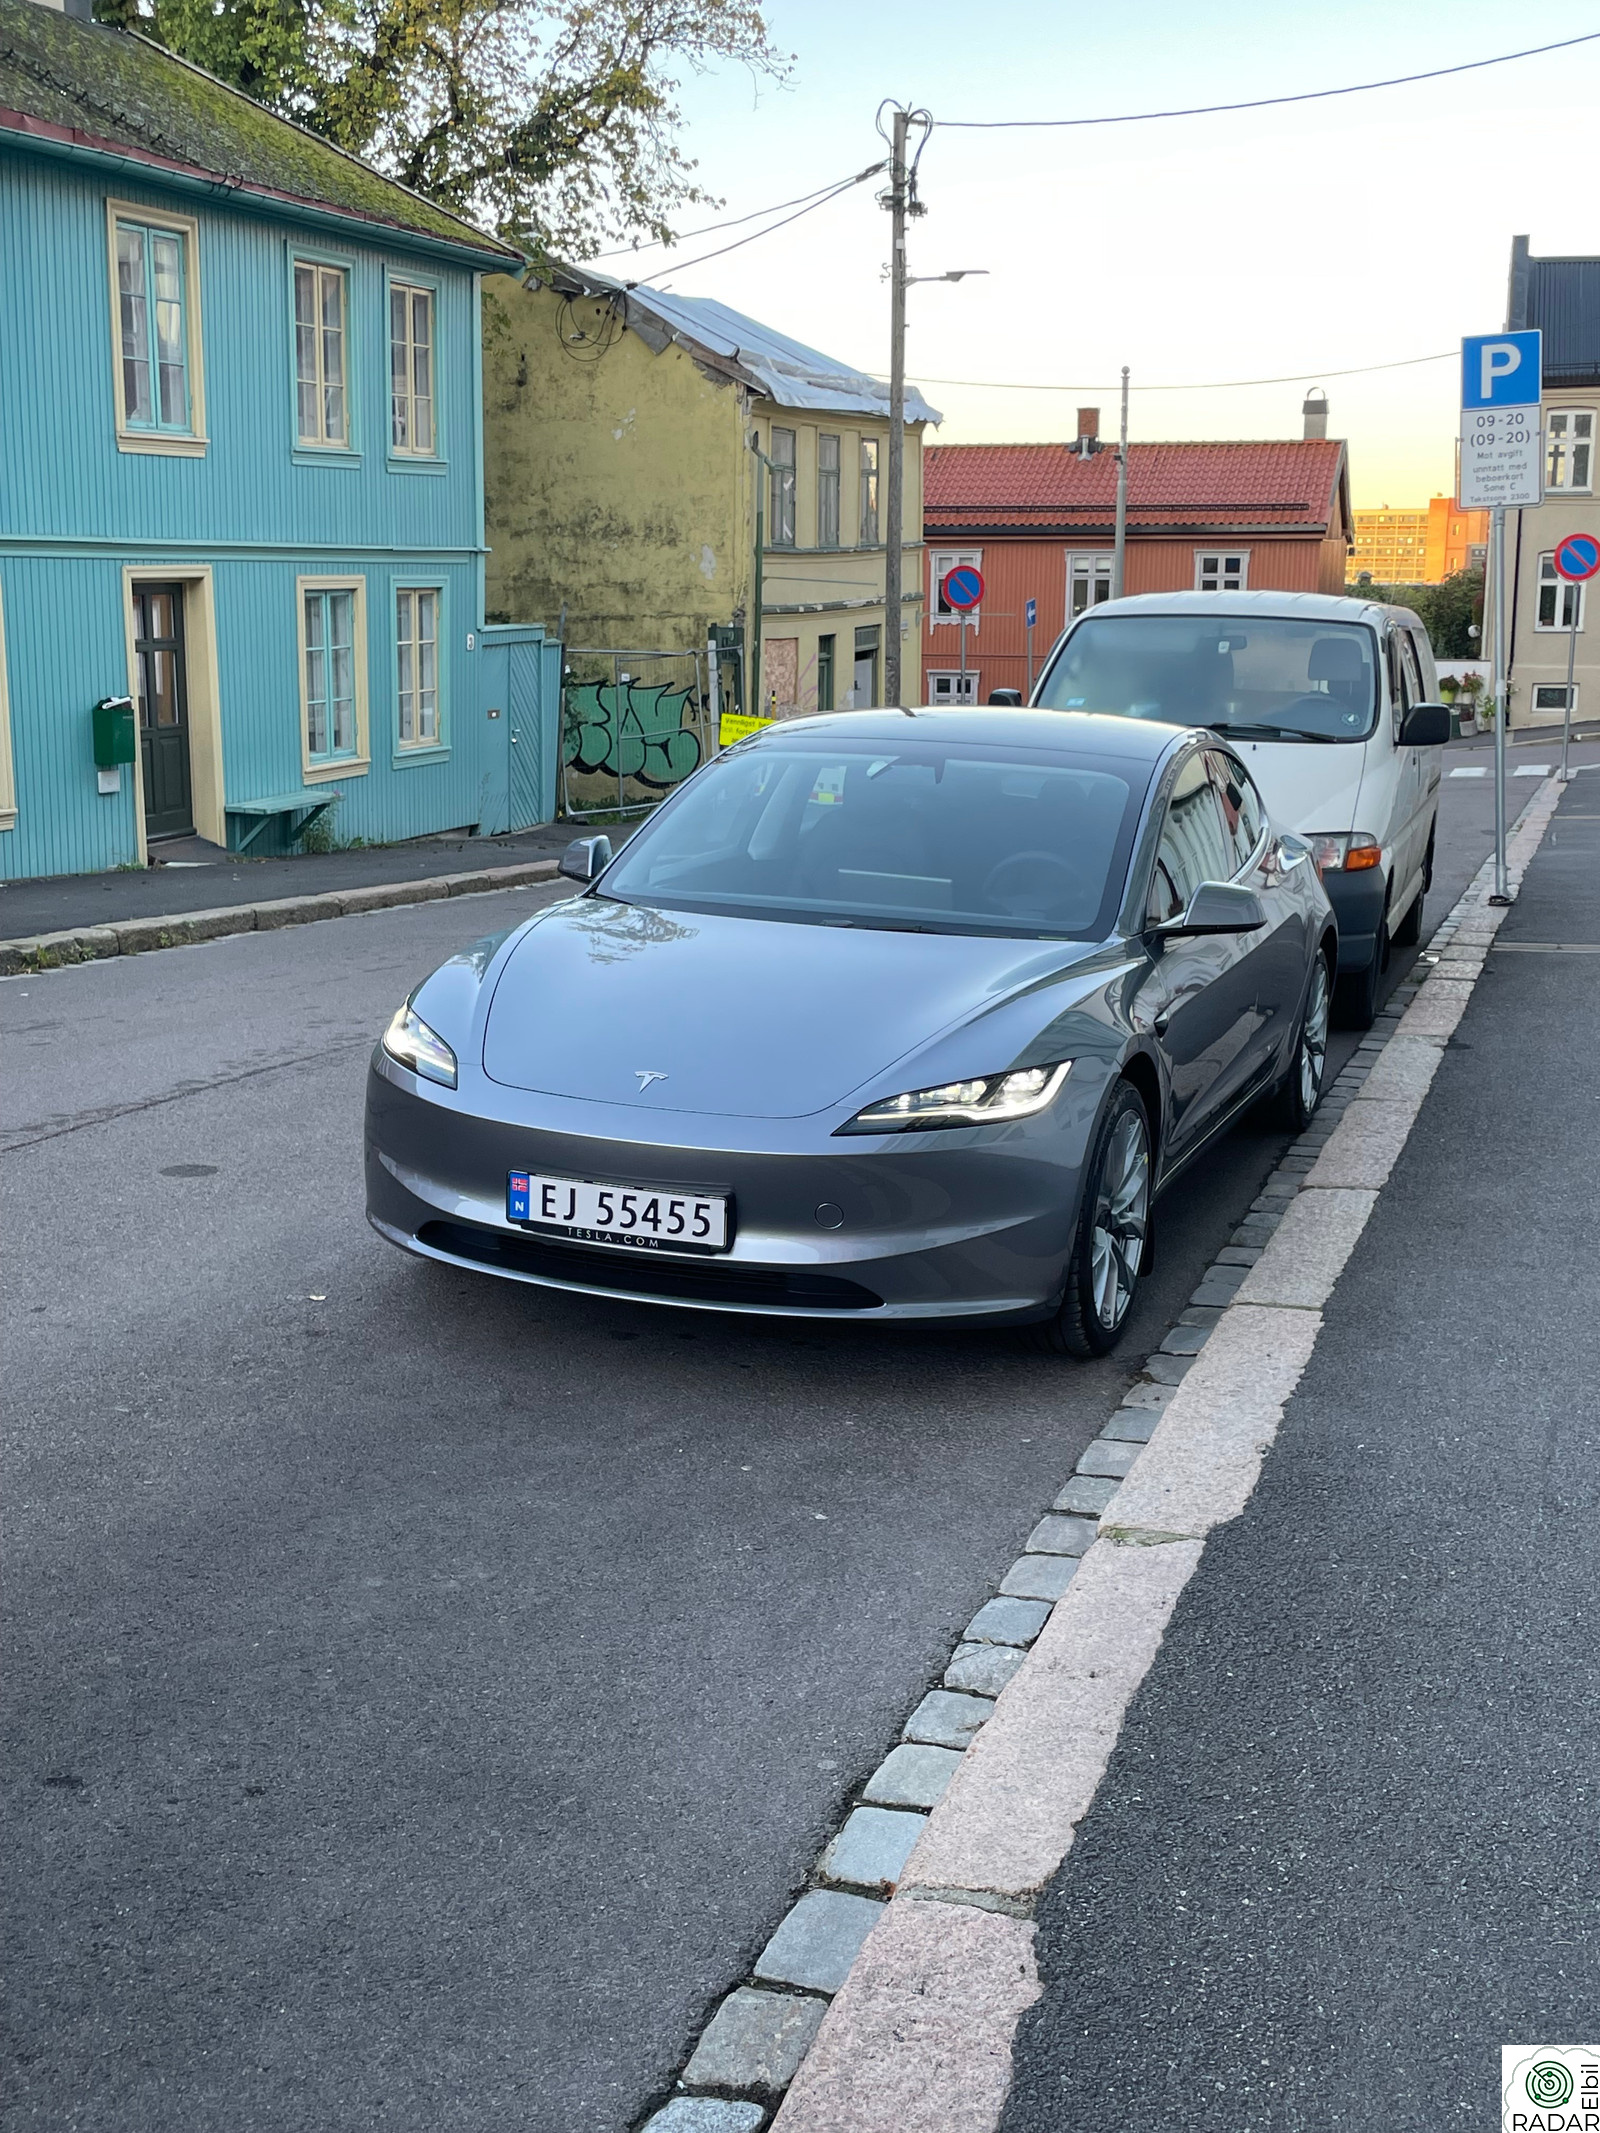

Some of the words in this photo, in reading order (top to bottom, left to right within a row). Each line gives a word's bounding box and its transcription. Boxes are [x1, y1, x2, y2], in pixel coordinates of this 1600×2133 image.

[1481, 343, 1522, 399] P
[1477, 452, 1493, 460] Mot
[1498, 449, 1523, 459] avgift
[1473, 464, 1504, 473] unntatt
[1508, 462, 1527, 471] med
[1475, 473, 1524, 483] beboerkort
[1484, 484, 1505, 492] Sone
[1510, 482, 1516, 490] C
[1510, 492, 1530, 501] 2300
[515, 1201, 525, 1212] N
[541, 1184, 576, 1221] EJ
[596, 1191, 711, 1237] 55455
[567, 1228, 660, 1248] TESLA.COM
